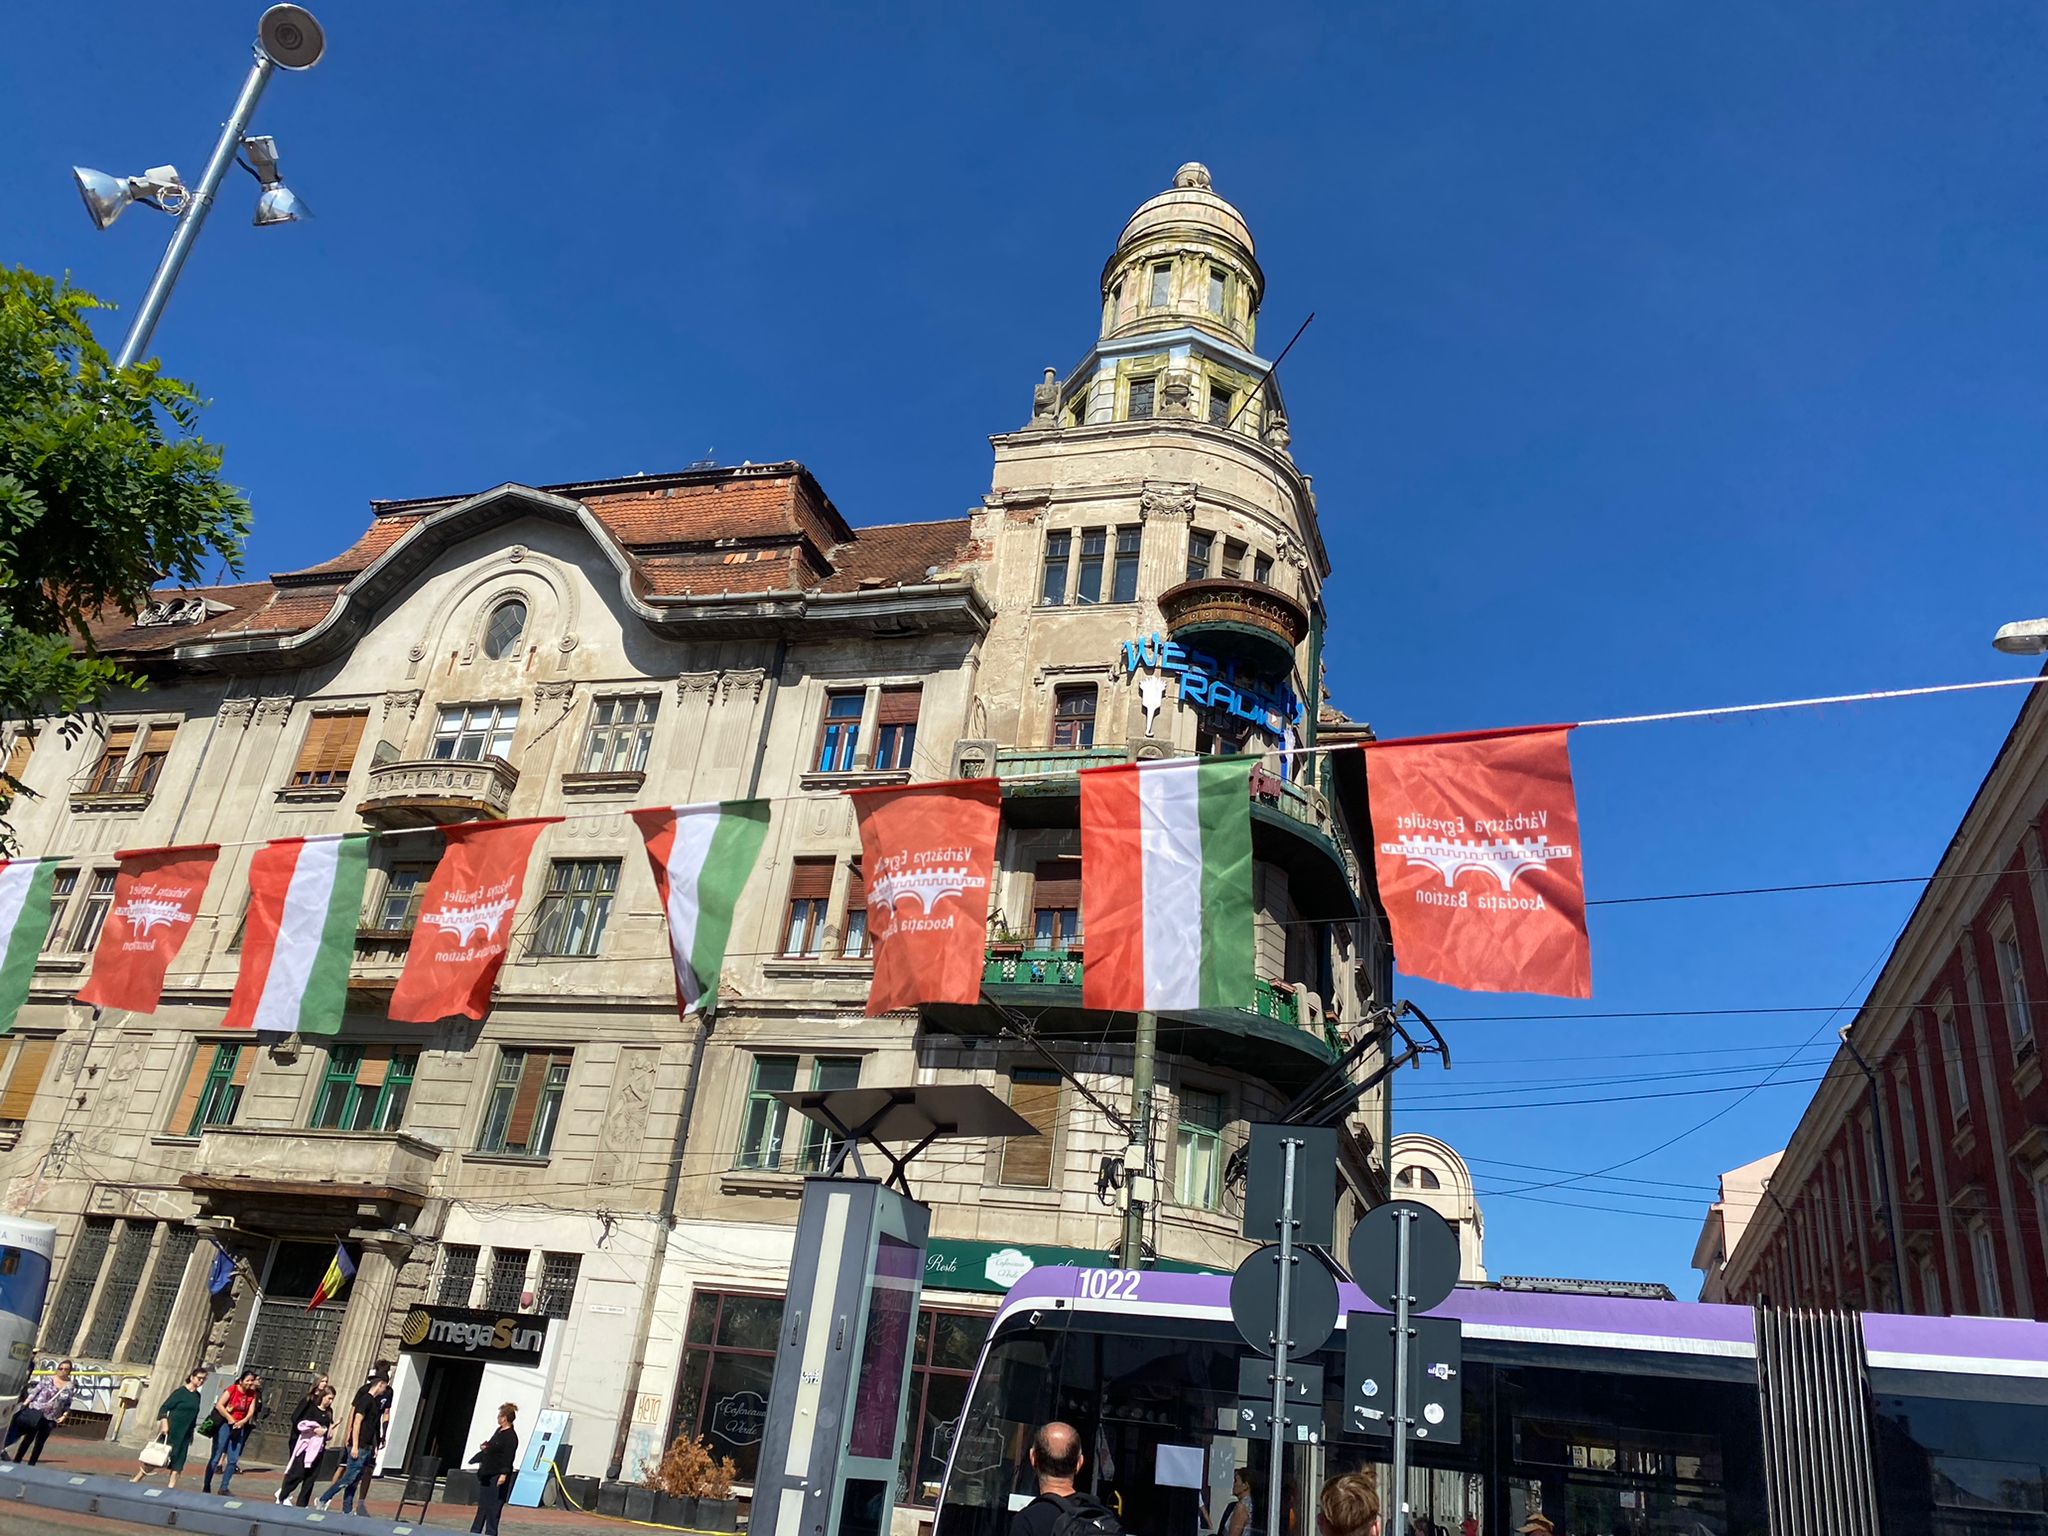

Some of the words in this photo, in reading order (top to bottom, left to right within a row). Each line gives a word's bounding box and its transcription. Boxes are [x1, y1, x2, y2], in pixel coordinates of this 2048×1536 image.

[1179, 671, 1283, 735] RADIO
[926, 1253, 957, 1272] Resto
[1079, 1269, 1141, 1300] 1022
[428, 1318, 543, 1352] megaSun
